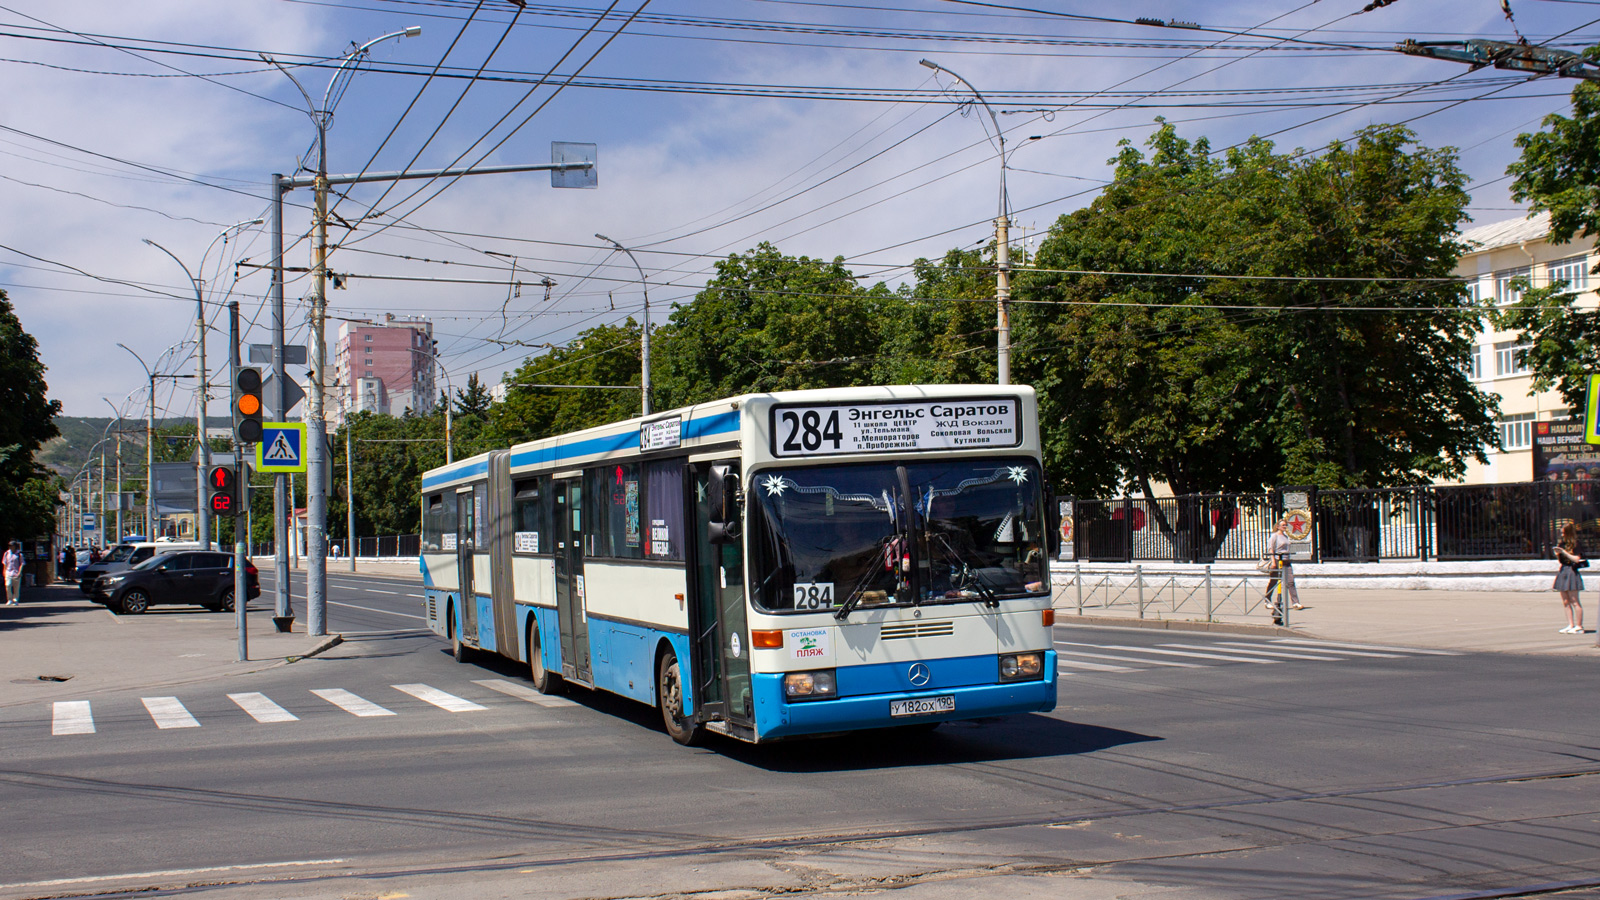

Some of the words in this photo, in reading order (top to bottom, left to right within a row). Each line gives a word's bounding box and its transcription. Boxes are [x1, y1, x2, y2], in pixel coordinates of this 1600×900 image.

[848, 408, 925, 421] Энгельс
[930, 405, 1009, 419] Саратов
[893, 419, 918, 427] ЦЕНТР
[962, 419, 1003, 427] Вокзал
[782, 410, 843, 452] 284
[977, 428, 1012, 436] Вольская
[1551, 425, 1567, 433] НАМ
[954, 437, 990, 445] Кутякова
[1536, 436, 1556, 444] НАША
[214, 496, 230, 510] 62
[796, 586, 832, 610] 284
[791, 630, 827, 638] ОСТАНОВКА
[796, 648, 824, 657] ПЛЯЖ
[937, 696, 952, 706] 190
